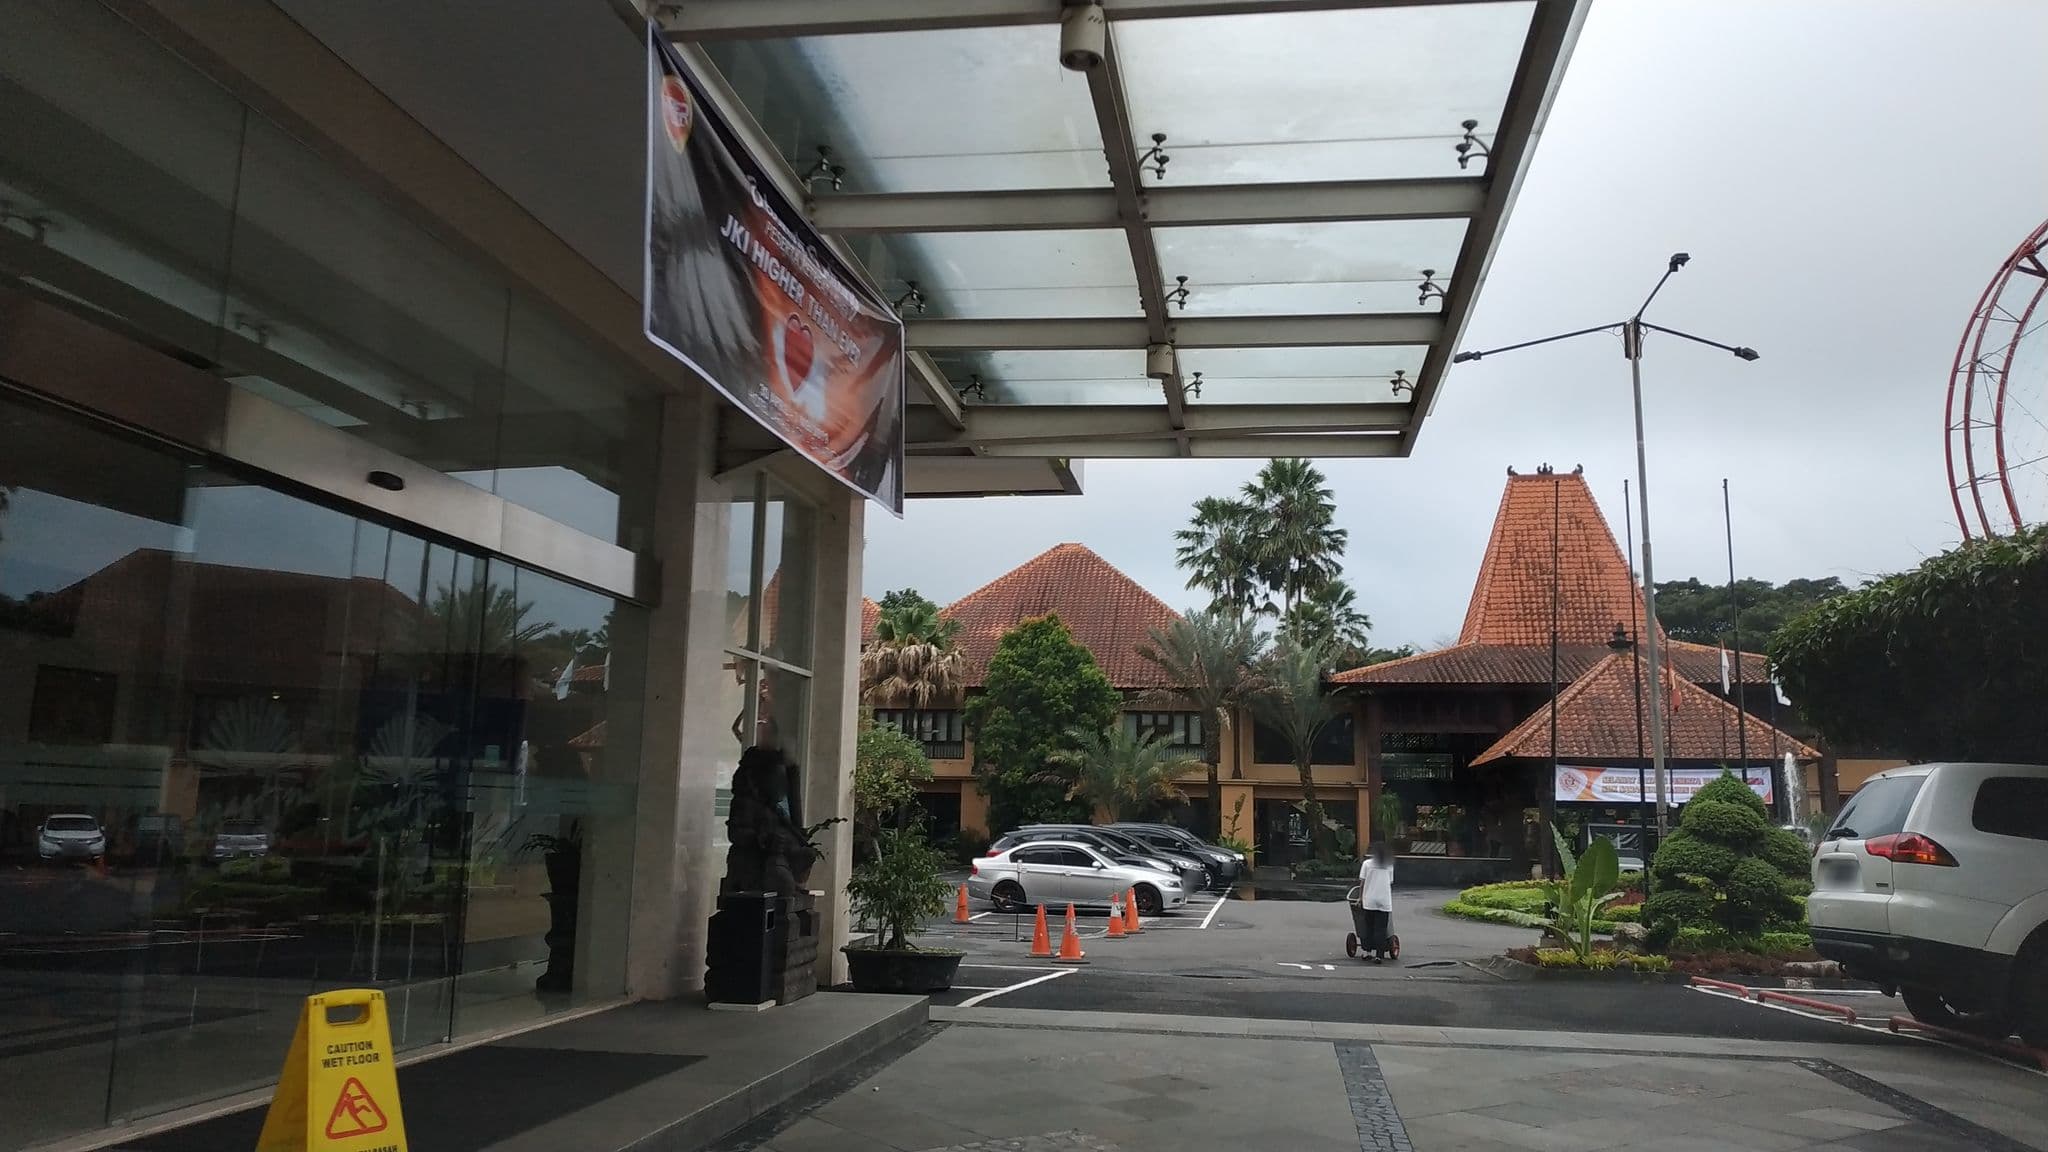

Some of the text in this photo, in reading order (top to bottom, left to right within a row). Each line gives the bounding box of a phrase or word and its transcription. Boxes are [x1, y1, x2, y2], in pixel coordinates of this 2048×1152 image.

[720, 214, 751, 255] JKI
[751, 240, 805, 309] HIGHER
[807, 294, 840, 343] THAN
[327, 1040, 373, 1054] CAUTION
[322, 1053, 379, 1068] WET FLOOR
